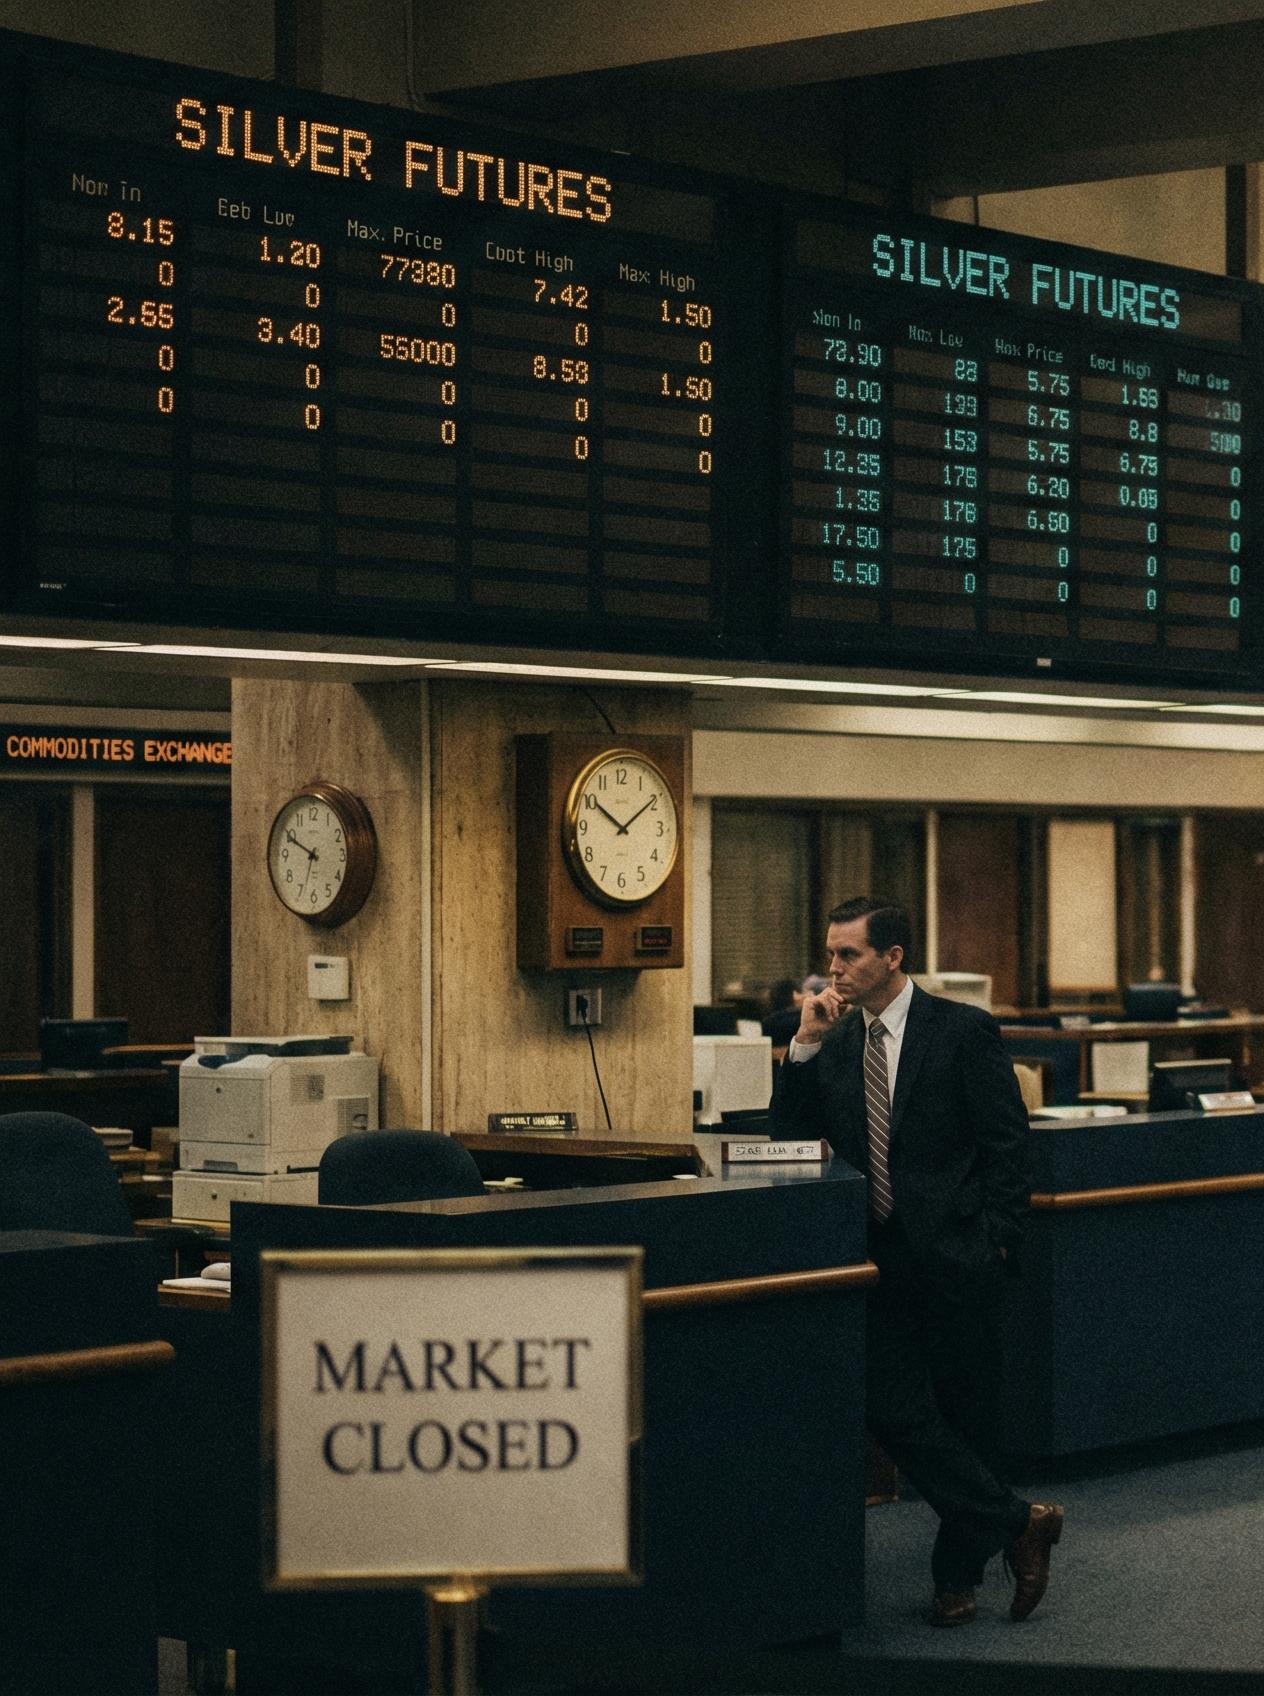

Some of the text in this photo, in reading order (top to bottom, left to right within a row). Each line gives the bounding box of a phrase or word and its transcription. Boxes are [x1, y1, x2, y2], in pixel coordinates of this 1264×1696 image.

[175, 97, 612, 223] SILVER FUTURES
[347, 219, 385, 242] Max.
[393, 225, 443, 251] Price
[535, 250, 574, 273] High
[659, 269, 696, 293] High
[107, 211, 712, 329] 8.15 1.20 77380 7.42 1.50
[872, 234, 1181, 330] SILVER FUTURES
[158, 260, 713, 365] 0 0 0 0 0
[257, 316, 321, 349] 3.40
[158, 344, 712, 437] 0 0 0 0 0
[1027, 369, 1070, 397] 5.75
[157, 386, 712, 474] 0 0 0 0 0
[1027, 404, 1070, 430] 6.75
[1128, 419, 1158, 443] 8.8
[835, 413, 882, 440] 9.00
[1229, 466, 1242, 488] 0
[1026, 474, 1070, 499] 6.20
[1229, 499, 1241, 521] 0
[1027, 509, 1070, 534] 6.50
[1146, 521, 1158, 544] 0
[1229, 531, 1241, 553] 0
[822, 522, 880, 550] 17.50
[1057, 546, 1069, 568] 0
[1146, 555, 1158, 577] 0
[1229, 564, 1241, 586] 0
[832, 560, 1241, 618] 5.50 0 0 0 0
[6, 735, 233, 765] COMMODITIES EXCHANGE
[598, 775, 607, 791] 11
[615, 768, 627, 785] 12
[584, 793, 598, 810] 10
[649, 793, 658, 811] 2
[308, 806, 319, 822] 12
[334, 828, 342, 843] 2
[579, 819, 588, 836] 9
[655, 820, 664, 838] 3
[281, 848, 289, 863] 9
[339, 847, 346, 863] 3
[584, 846, 593, 862] 8
[649, 847, 658, 862] 4
[286, 868, 293, 884] 8
[600, 865, 608, 882] 7
[617, 871, 626, 888] 6
[637, 865, 645, 882] 5
[298, 883, 304, 898] 7
[310, 888, 318, 904] 6
[325, 883, 332, 898] 5
[312, 1336, 591, 1394] MARKET
[321, 1418, 580, 1476] CLOSED
